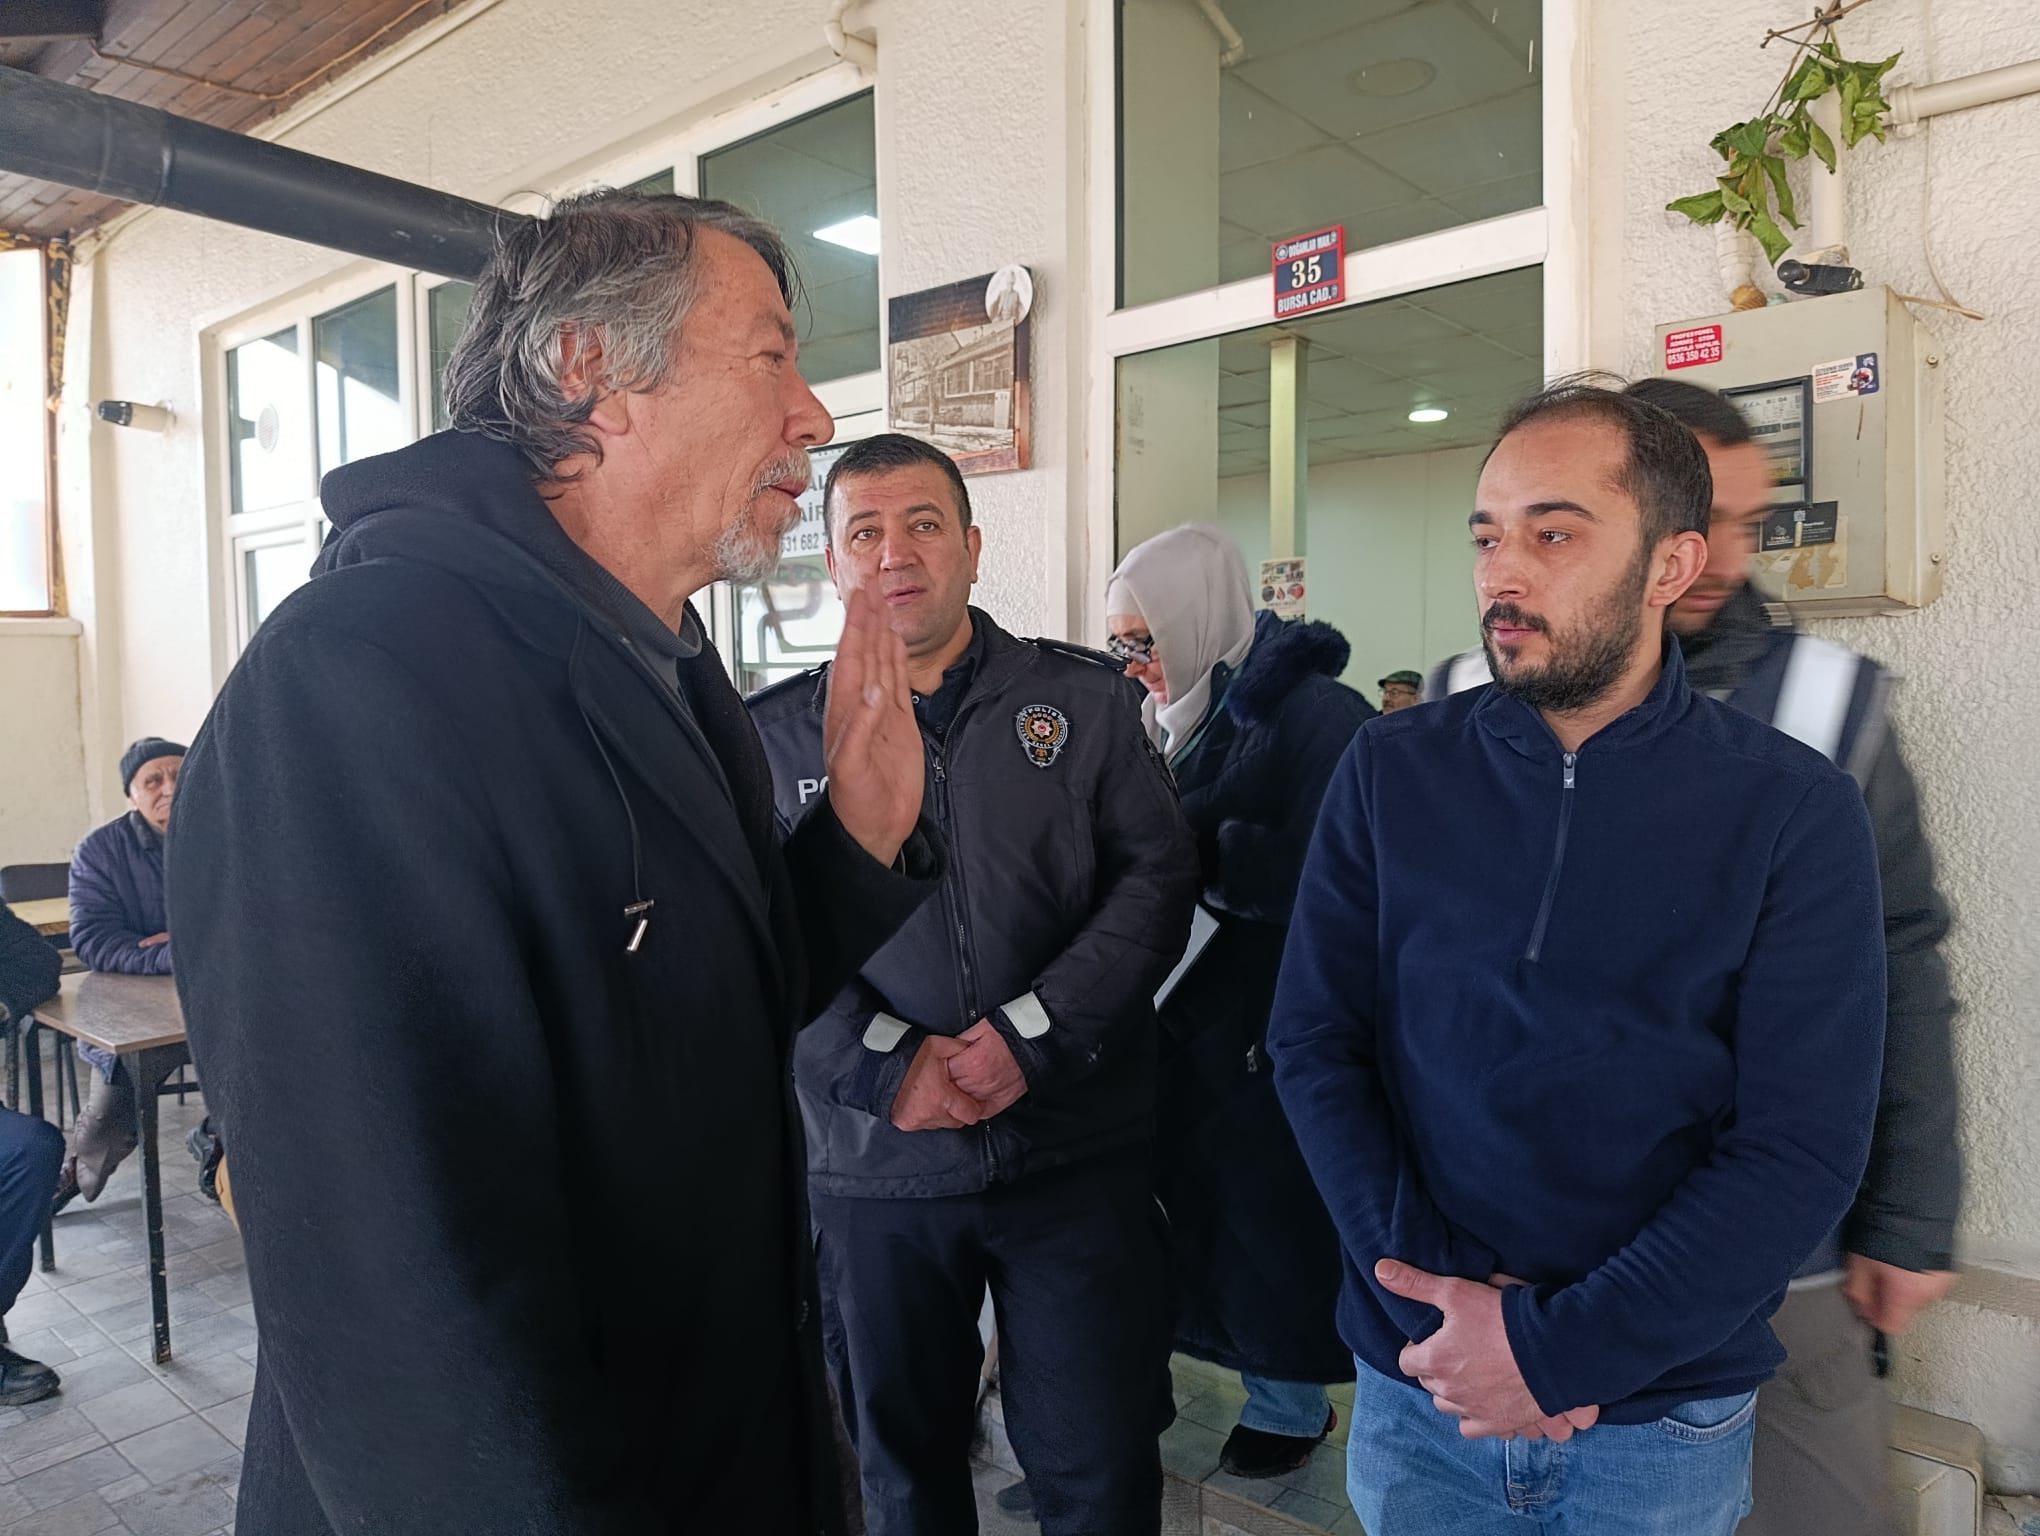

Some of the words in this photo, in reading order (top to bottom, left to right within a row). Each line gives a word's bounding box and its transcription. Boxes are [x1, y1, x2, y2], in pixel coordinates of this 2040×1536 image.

[1291, 255, 1322, 289] 35
[1278, 292, 1308, 313] BURSA
[1309, 286, 1332, 304] CAD.
[1667, 352, 1685, 365] 0536
[1685, 350, 1699, 362] 350
[1700, 348, 1710, 358] 42
[1710, 346, 1720, 357] 35
[800, 531, 820, 551] 682
